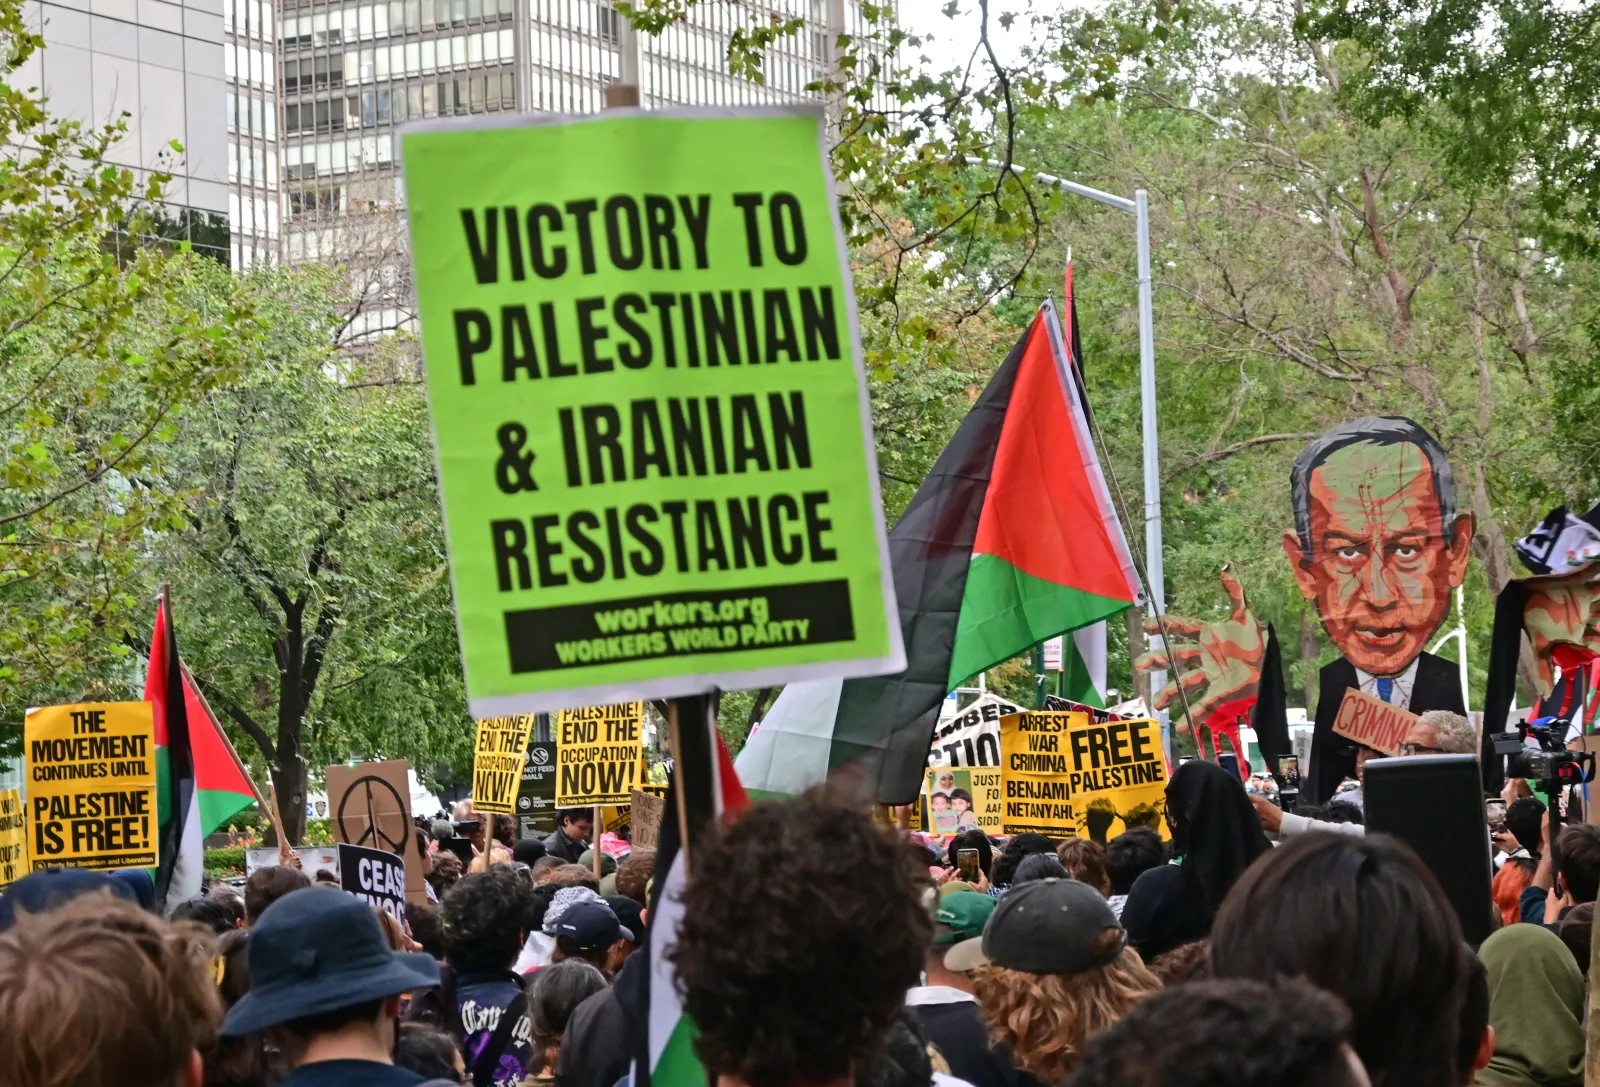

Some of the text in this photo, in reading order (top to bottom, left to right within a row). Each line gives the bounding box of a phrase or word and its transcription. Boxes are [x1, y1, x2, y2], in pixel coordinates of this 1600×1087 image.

[460, 191, 808, 285] VICTORY TO
[453, 286, 840, 386] PALESTINIAN
[495, 390, 812, 494] & IRANIAN
[490, 490, 837, 593] RESISTANCE
[595, 596, 769, 633] workers.org
[555, 618, 809, 664] WORKERS WORLD PARTY
[70, 710, 107, 734] THE
[562, 719, 639, 745] END THE
[1018, 714, 1071, 733] ARREST
[31, 734, 149, 763] MOVEMENT
[499, 731, 526, 753] THE
[561, 746, 638, 763] OCCUPATION
[1028, 733, 1059, 753] WAR
[1070, 721, 1155, 771] FREE
[32, 760, 149, 782] CONTINUES UNTIL
[1010, 753, 1068, 773] CRIMINA
[1070, 760, 1165, 794] PALESTINE
[561, 761, 635, 796] NOW!
[1006, 780, 1070, 801] BENJAMI
[33, 790, 150, 821] PALESTINE
[35, 816, 150, 856] IS FREE!
[66, 860, 77, 868] for
[77, 859, 107, 867] Socialism
[121, 856, 154, 864] Liberation
